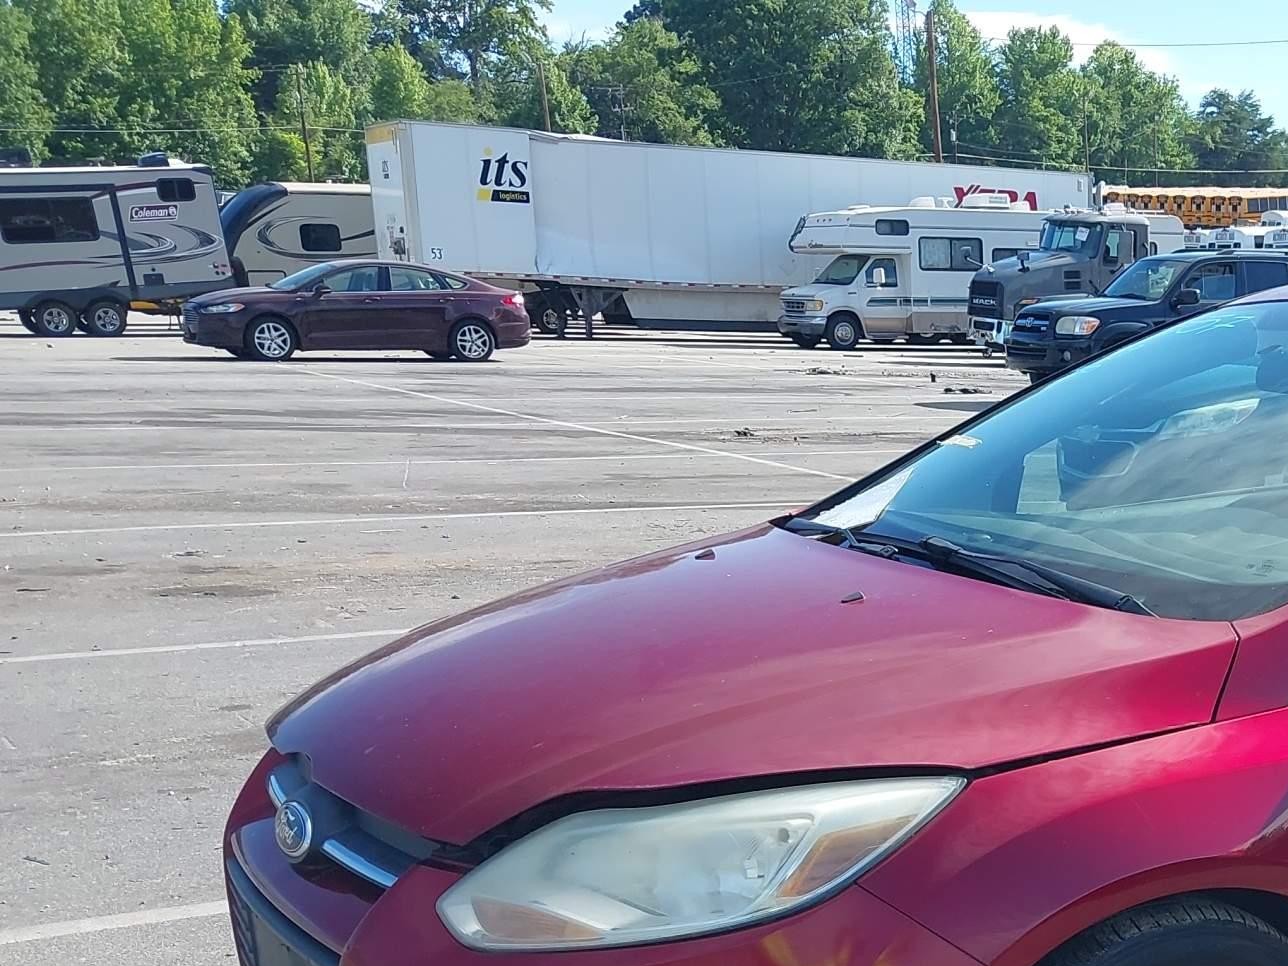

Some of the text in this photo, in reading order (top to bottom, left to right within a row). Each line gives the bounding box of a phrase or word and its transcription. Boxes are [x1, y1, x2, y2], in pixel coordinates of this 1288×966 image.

[479, 147, 528, 189] its
[499, 191, 527, 201] logistics
[132, 206, 168, 218] Coleman
[973, 297, 997, 306] MACK
